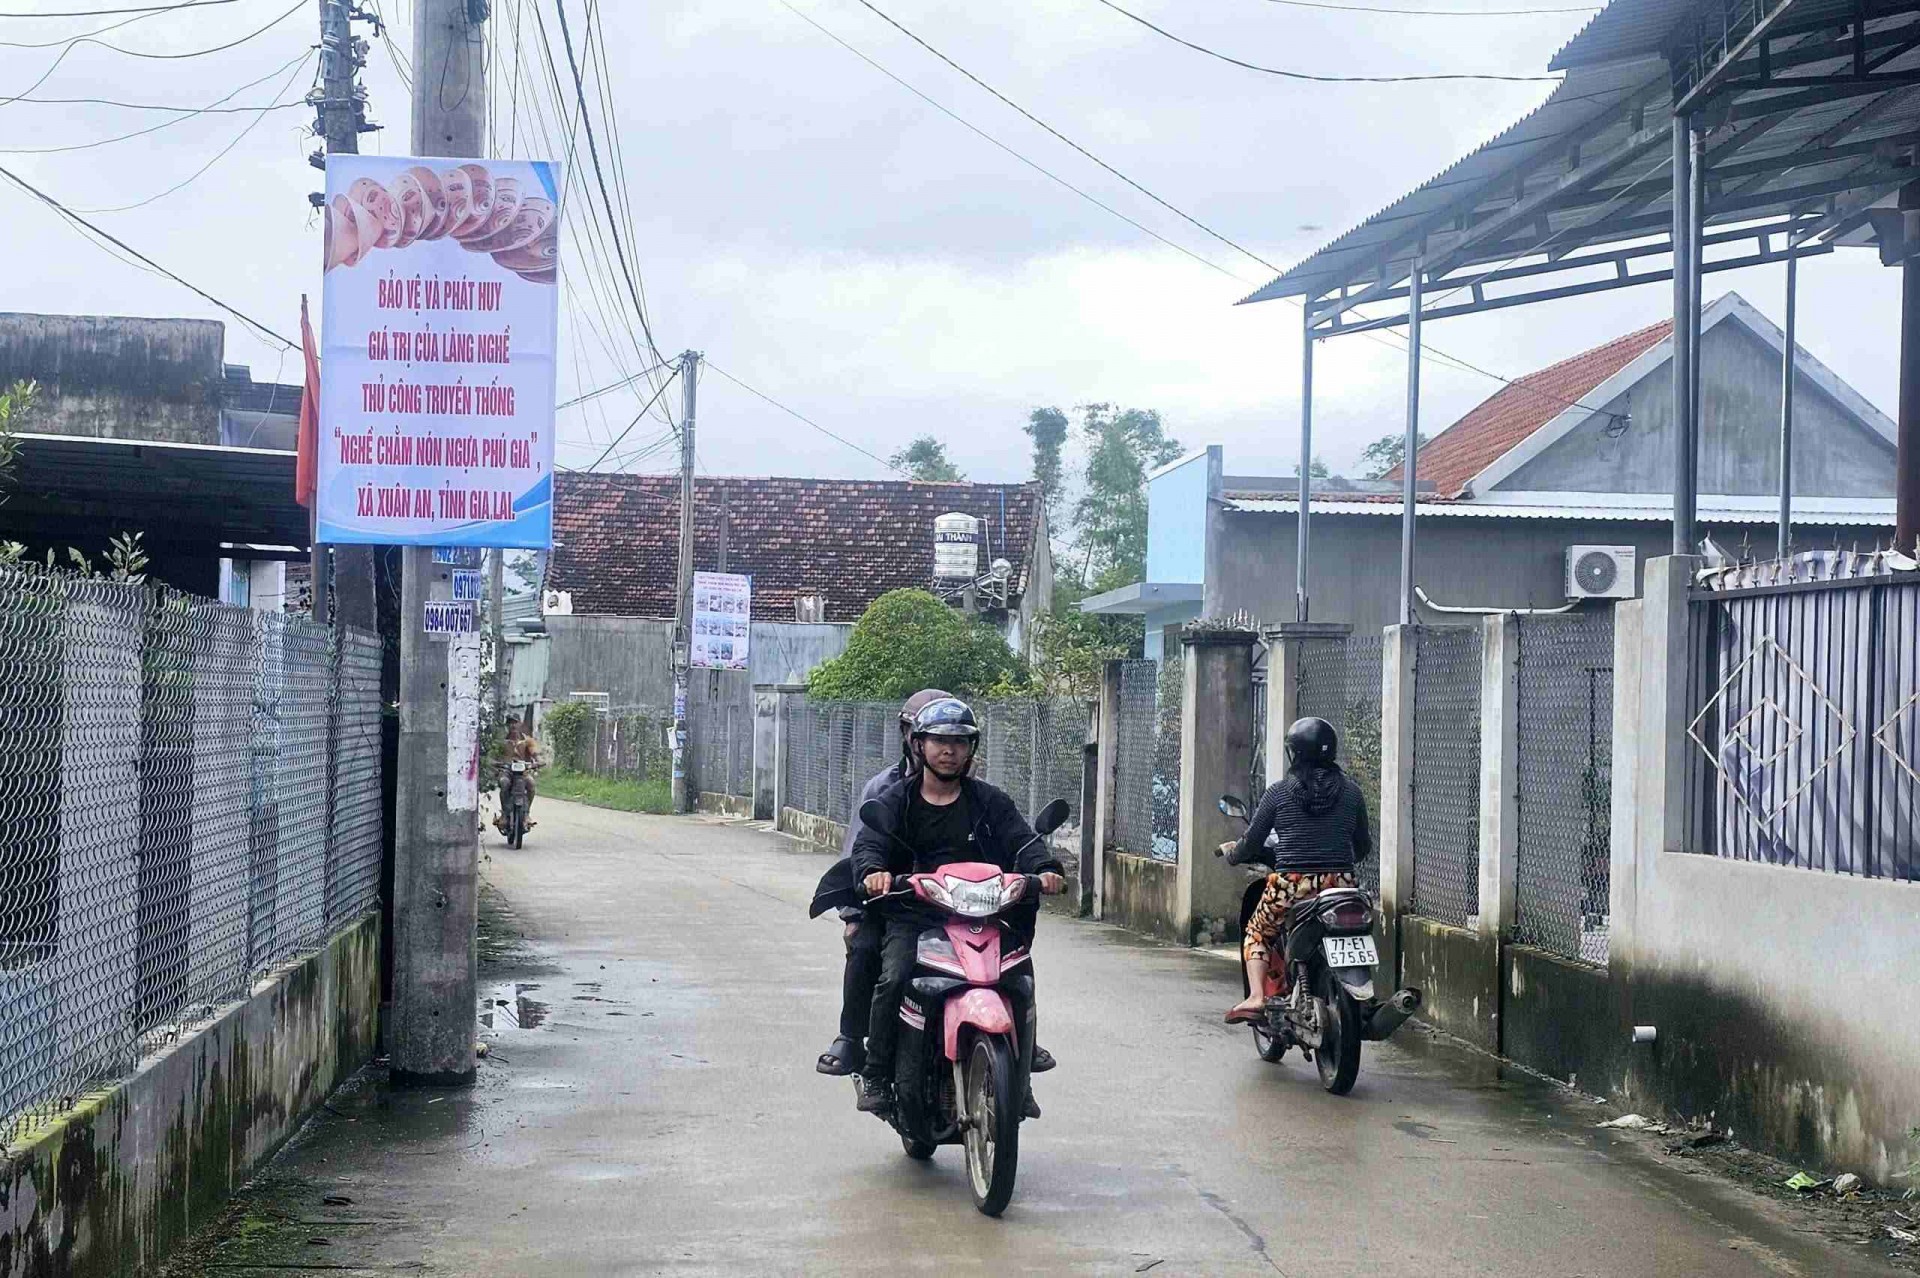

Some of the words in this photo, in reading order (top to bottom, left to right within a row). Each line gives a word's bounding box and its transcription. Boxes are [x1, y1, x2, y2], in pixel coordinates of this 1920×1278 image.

[378, 269, 403, 309] BẢO
[407, 273, 421, 316] VỆ
[425, 273, 440, 310] VÀ
[443, 275, 475, 311] PHÁT
[478, 281, 502, 312] HUY
[368, 325, 389, 361] GIÁ
[392, 331, 411, 368] TRỊ
[415, 322, 439, 362] CỦA
[442, 326, 474, 363] LÀNG
[477, 324, 510, 364] NGHỀ
[362, 373, 385, 412] THỦ
[389, 377, 422, 414] CÔNG
[475, 375, 515, 416] THỐNG
[377, 424, 413, 466] CHẰM
[416, 430, 442, 466] NÓN
[445, 435, 479, 474] NGỰA
[482, 432, 507, 468] PHÚ
[357, 482, 374, 517] XÃ
[377, 482, 411, 518] XUÂN
[413, 488, 435, 523] AN,
[438, 479, 466, 519] TỈNH
[1330, 950, 1375, 964] 575.65
[1331, 938, 1366, 951] 77-E1
